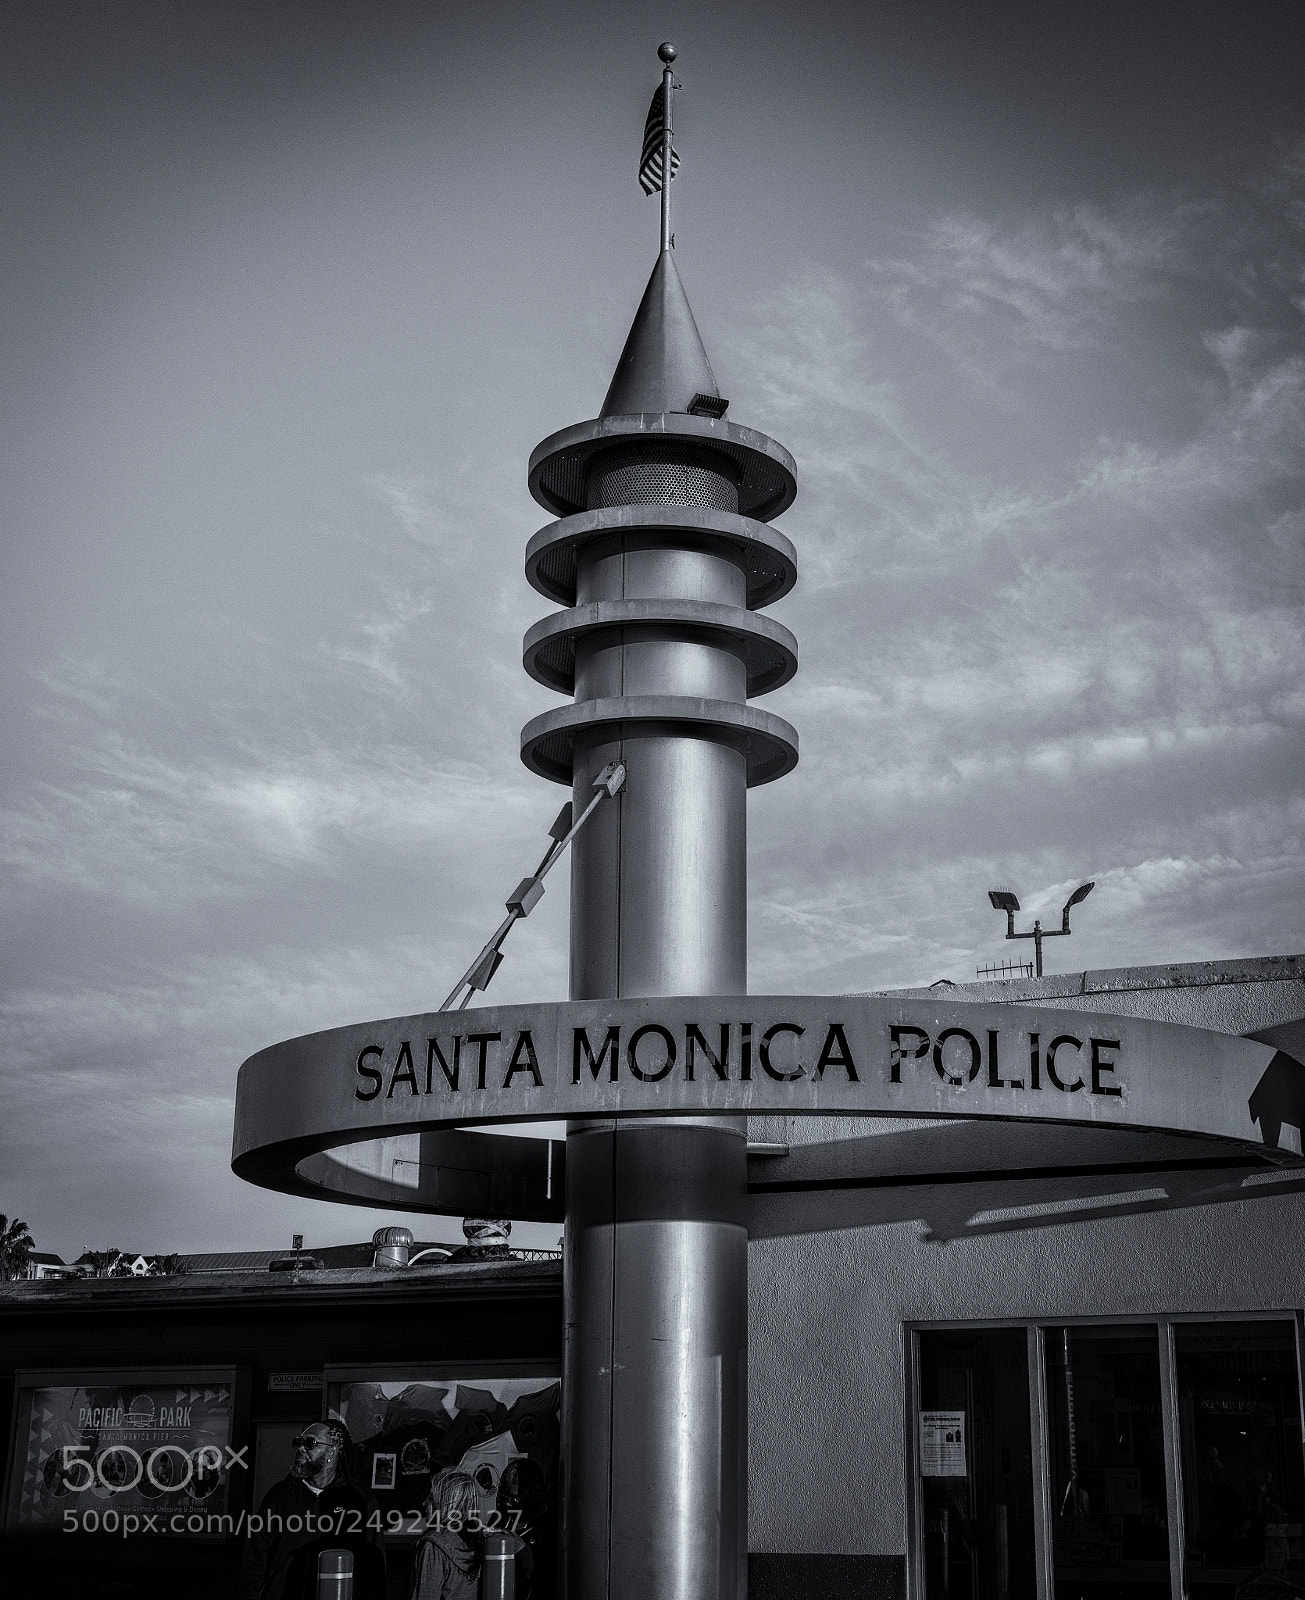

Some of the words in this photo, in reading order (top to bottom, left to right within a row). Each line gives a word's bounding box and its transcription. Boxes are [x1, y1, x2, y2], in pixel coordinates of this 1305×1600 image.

[354, 1029, 545, 1102] SANTA
[570, 1022, 861, 1085] MONICA
[888, 1023, 1123, 1099] POLICE
[78, 1406, 123, 1428] PACIFIC
[159, 1406, 192, 1427] PARK
[98, 1432, 120, 1441] SANTA
[123, 1432, 150, 1441] MONICA
[152, 1432, 169, 1441] PIER
[156, 1505, 183, 1514] Shopping
[189, 1505, 208, 1514] Dining
